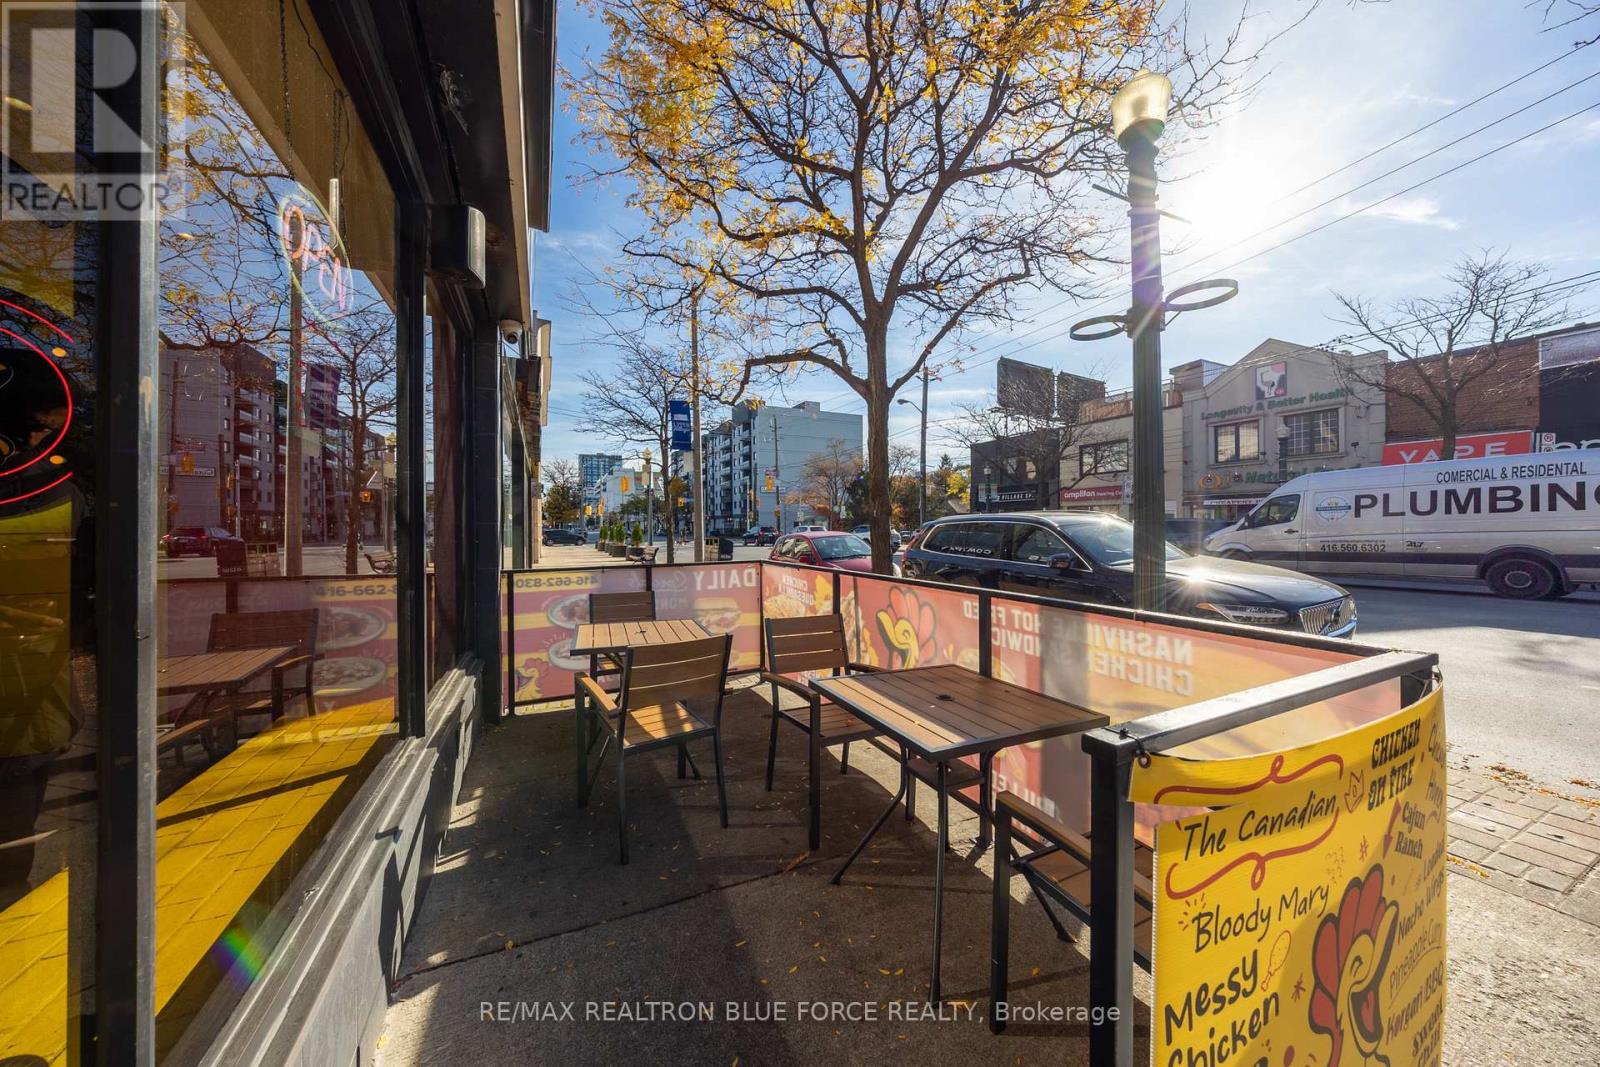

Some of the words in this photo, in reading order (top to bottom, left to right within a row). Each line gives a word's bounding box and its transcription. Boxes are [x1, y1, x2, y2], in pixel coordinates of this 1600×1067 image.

[1064, 489, 1096, 500] amplifon
[1436, 468, 1497, 484] COMERCIAL
[1500, 466, 1508, 480] &
[1511, 461, 1588, 478] RESIDENTAL
[1320, 543, 1387, 553] 416.560.6302
[1389, 754, 1415, 799] FIRE
[1184, 815, 1227, 862] The
[1238, 789, 1337, 842] Canadian
[1191, 898, 1272, 954] Bloody
[1278, 884, 1330, 921] Mary
[1164, 949, 1258, 1047] Messy
[1167, 992, 1280, 1067] Chicken
